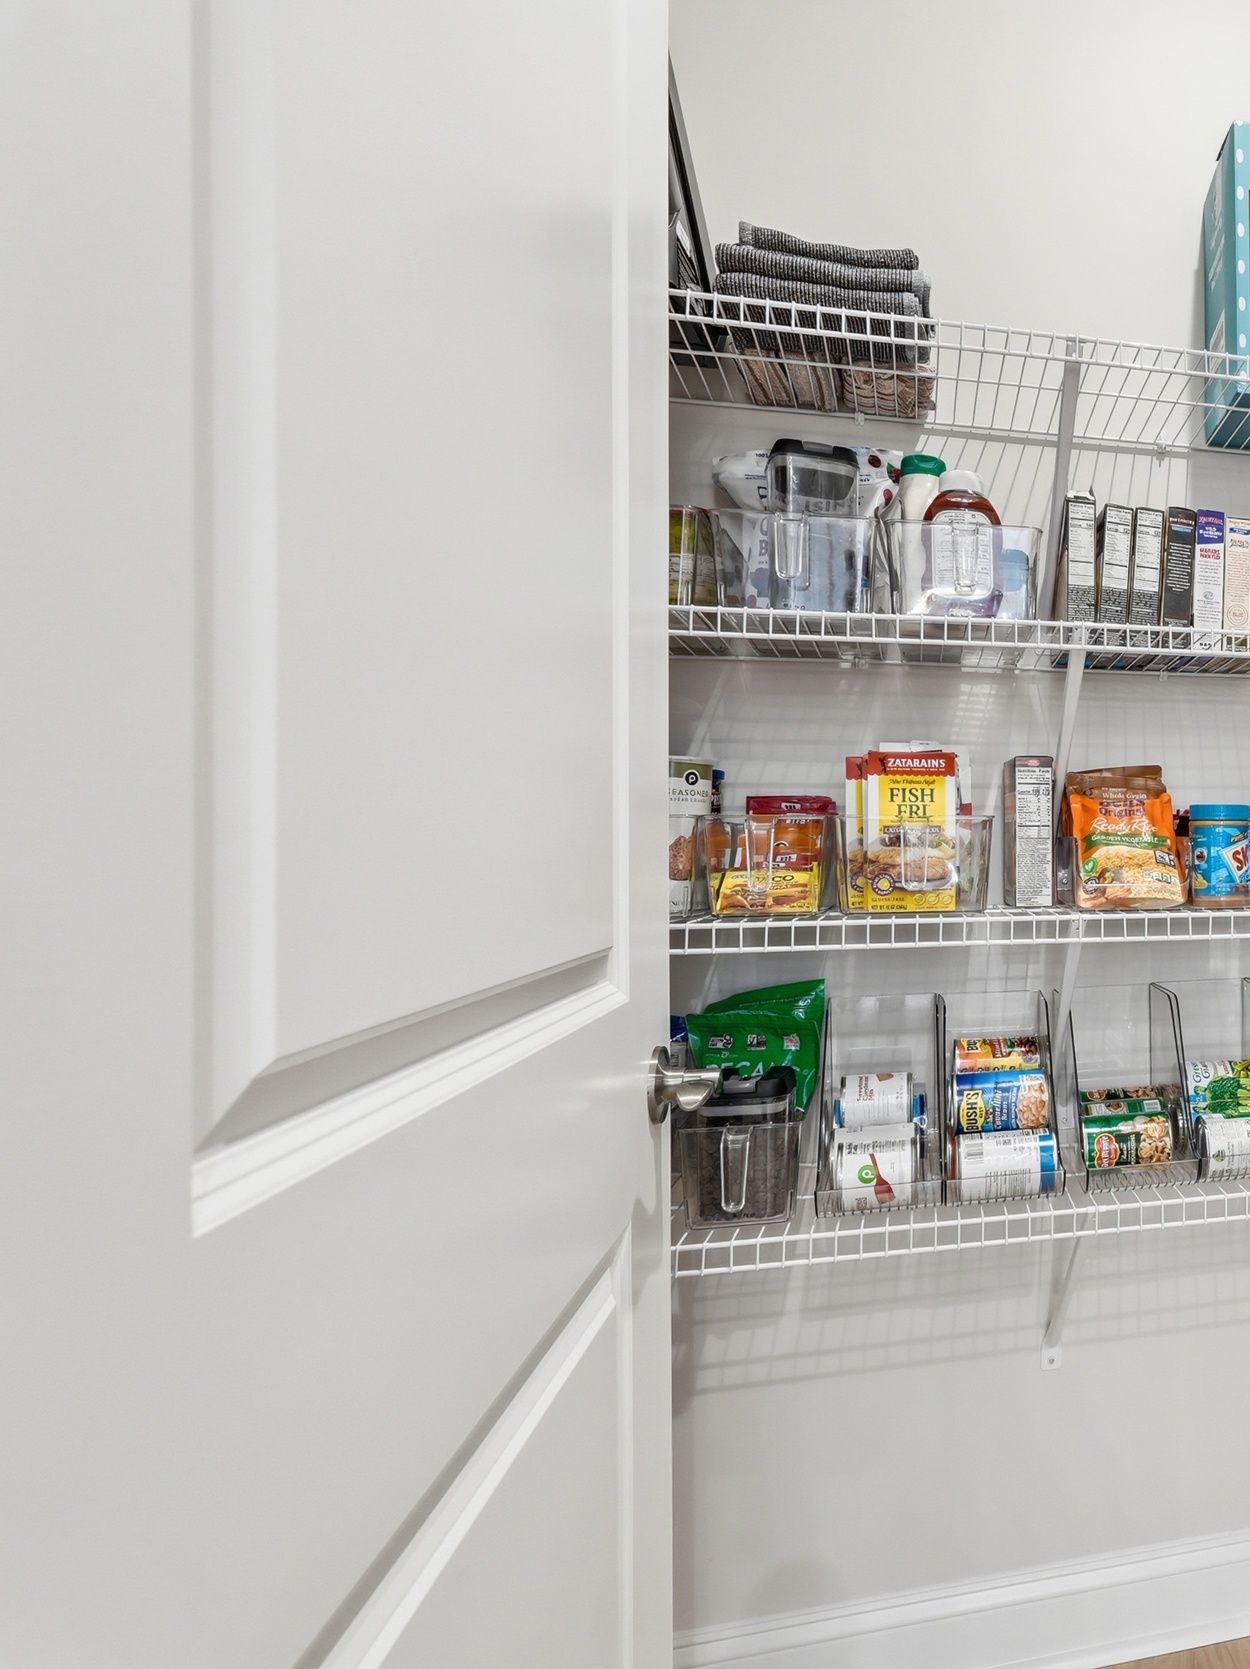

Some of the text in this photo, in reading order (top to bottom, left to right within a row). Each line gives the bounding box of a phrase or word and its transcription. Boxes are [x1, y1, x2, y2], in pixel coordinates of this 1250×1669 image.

[889, 787, 936, 803] FISH
[1090, 816, 1131, 835] Ready
[965, 1090, 980, 1131] BUSH'S
